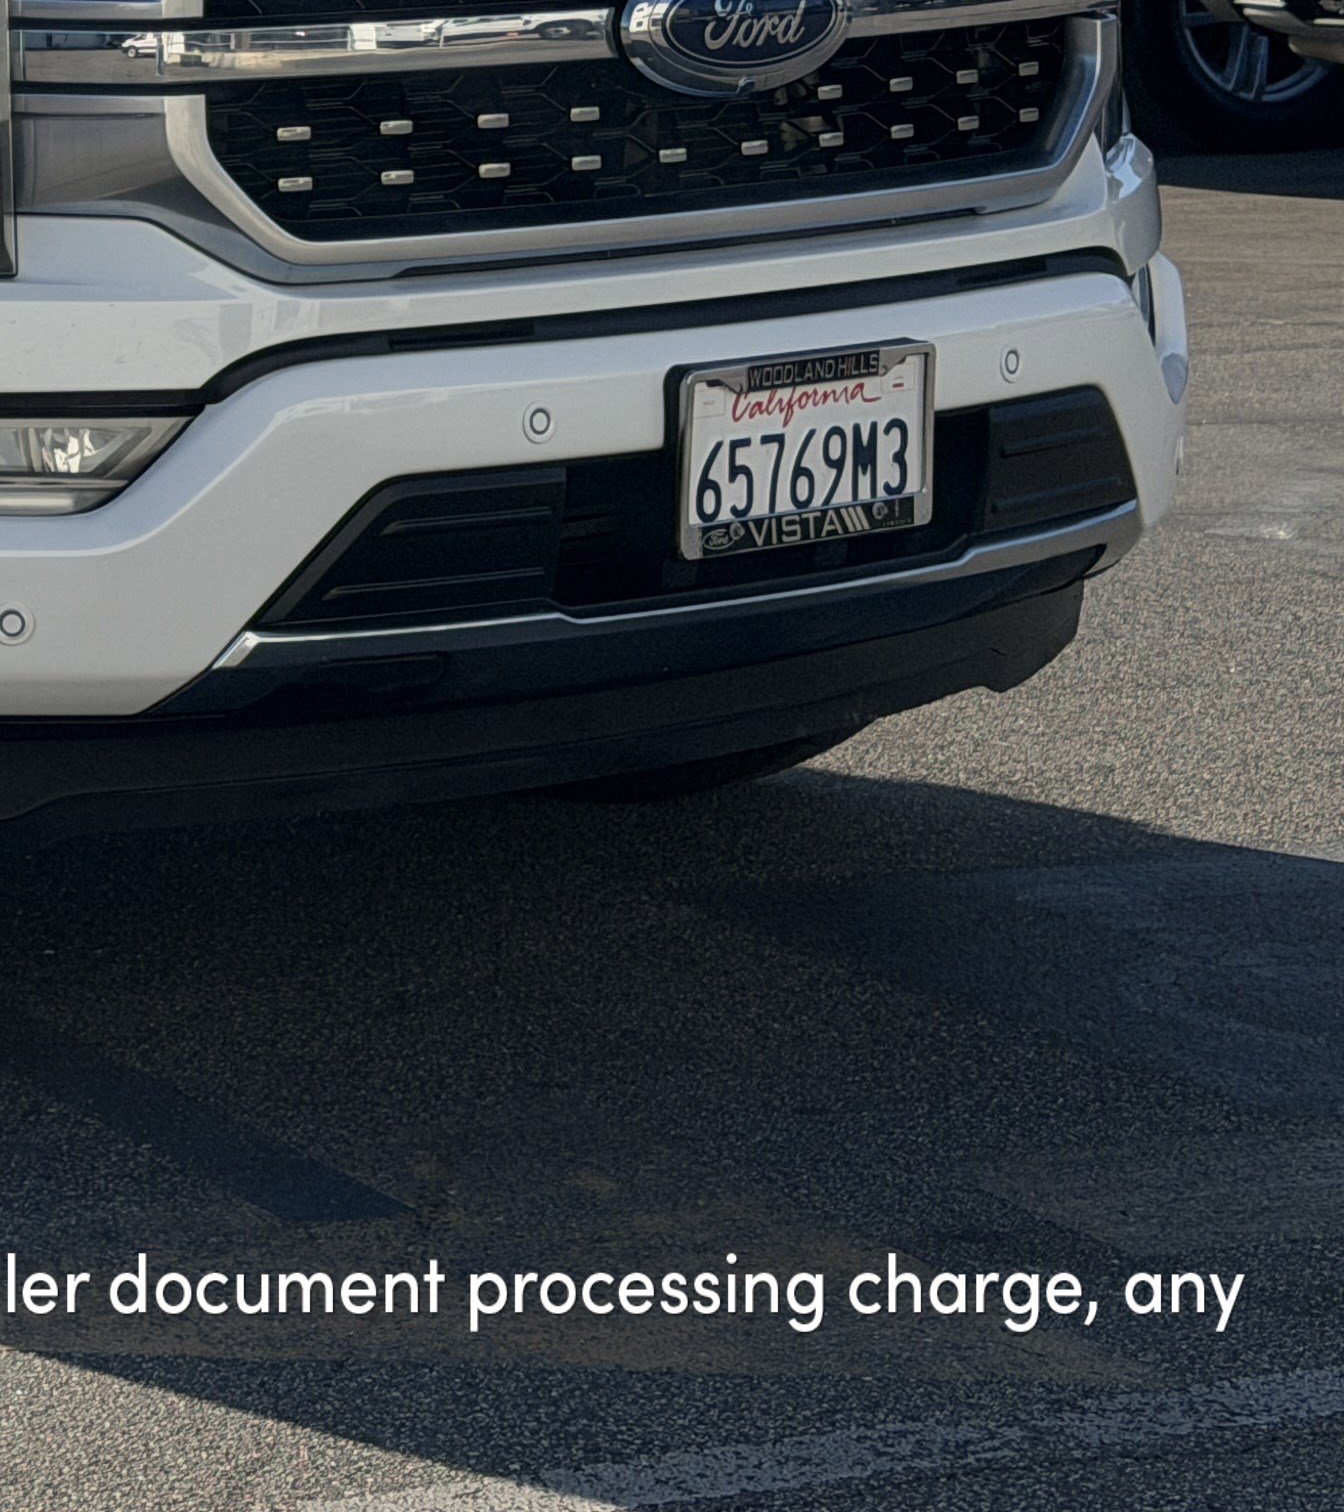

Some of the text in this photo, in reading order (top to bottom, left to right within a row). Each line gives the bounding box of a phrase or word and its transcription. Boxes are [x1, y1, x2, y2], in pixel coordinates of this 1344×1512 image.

[749, 353, 879, 388] WOODLAND HILLS
[731, 381, 882, 429] California
[695, 418, 909, 524] 65769M3
[747, 508, 845, 547] VISTA
